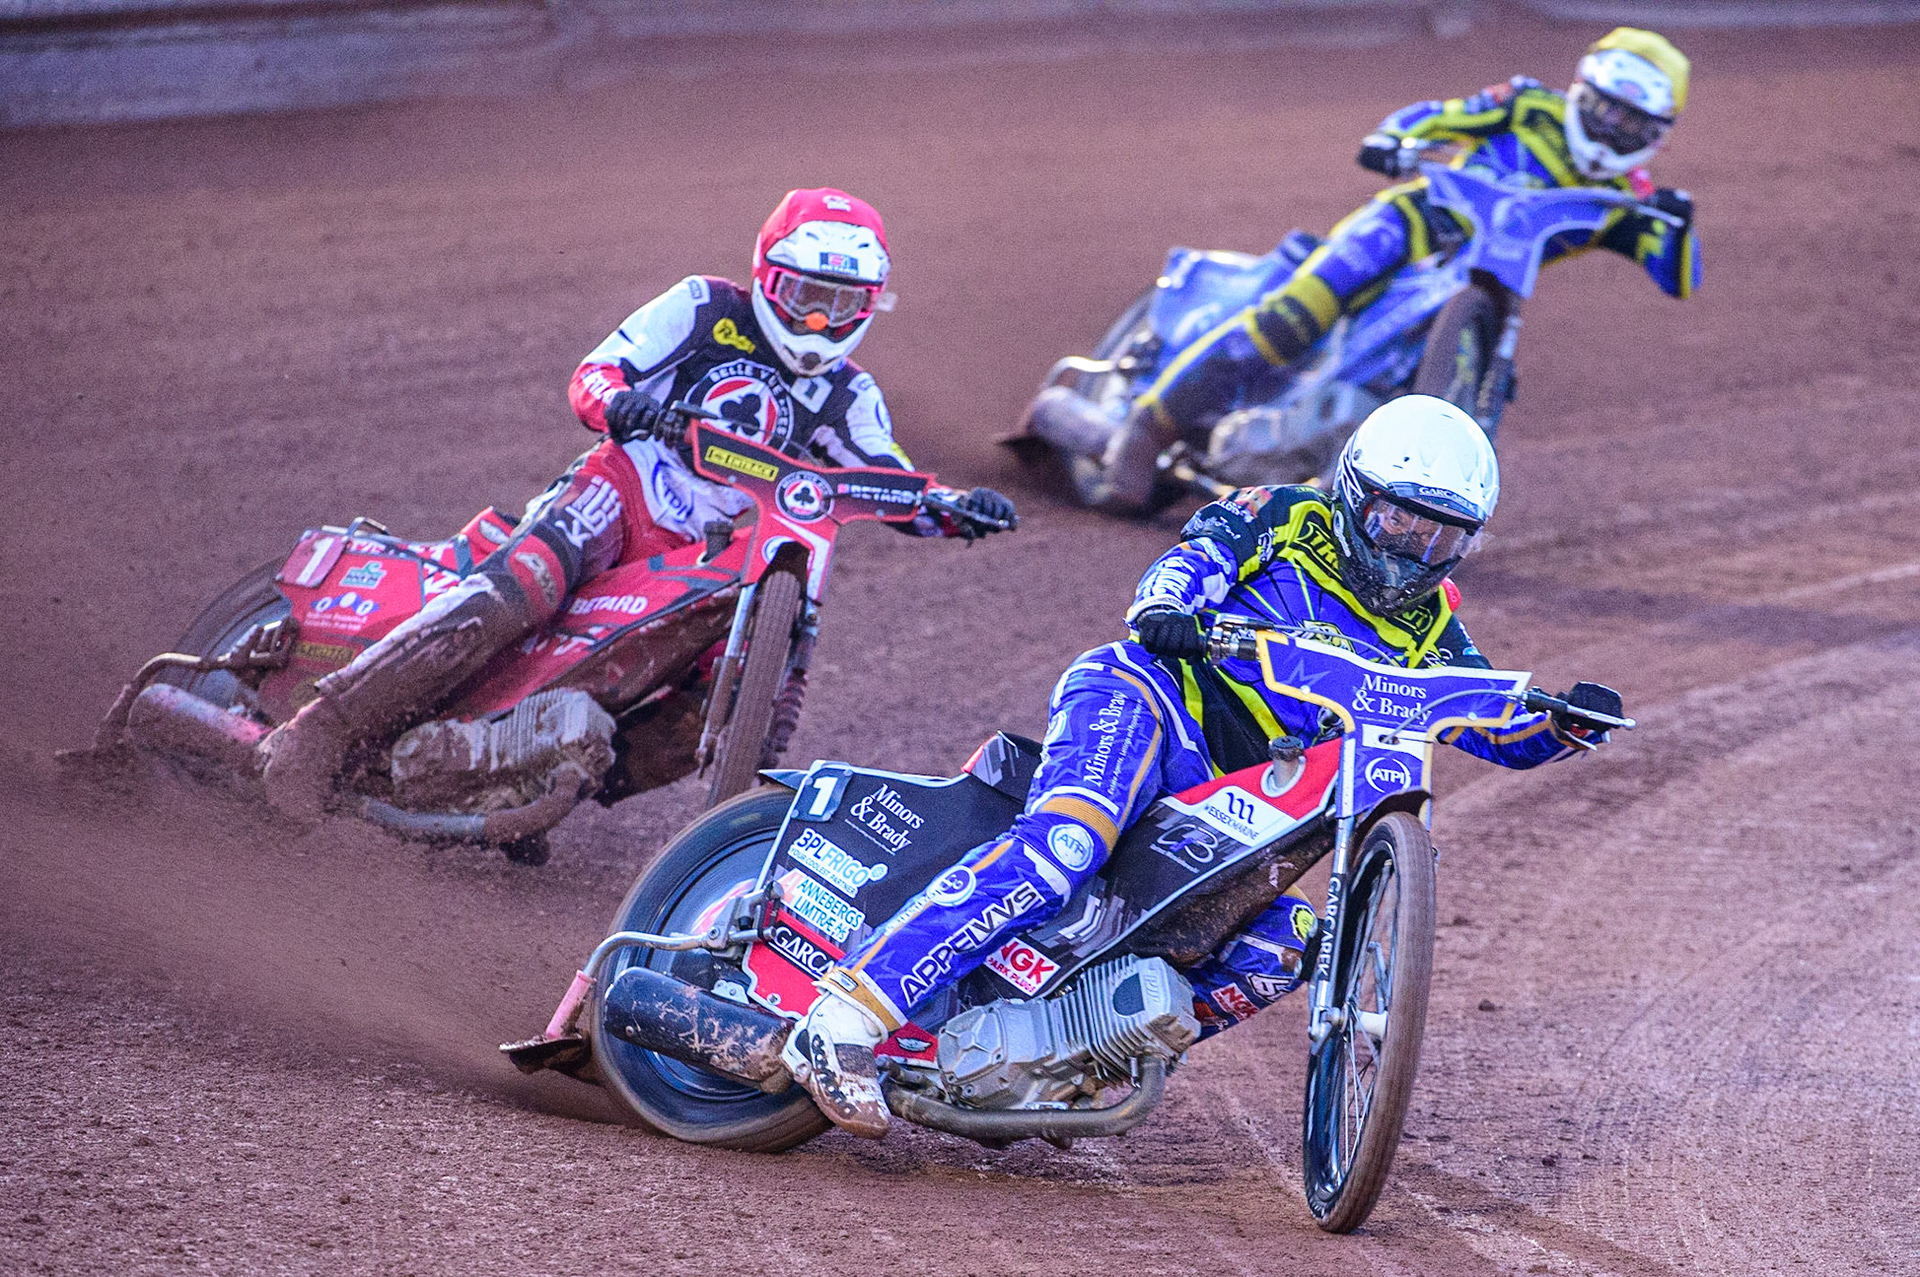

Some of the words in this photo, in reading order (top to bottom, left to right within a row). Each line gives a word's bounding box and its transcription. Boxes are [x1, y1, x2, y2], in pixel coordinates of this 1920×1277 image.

[709, 363, 754, 383] BELLE
[295, 537, 335, 584] 1
[1352, 689, 1376, 713] &
[1378, 697, 1433, 726] Brady
[1361, 673, 1427, 699] Minors
[1088, 718, 1119, 734] &
[1083, 734, 1115, 787] Minors
[1371, 767, 1405, 785] ATPI
[808, 776, 839, 816] 1
[870, 783, 925, 829] Minors
[850, 796, 875, 822] &
[866, 811, 913, 852] Brady
[796, 831, 869, 885] 3PLFRIGO
[797, 879, 862, 928] ANNEBERGS
[1318, 876, 1342, 976] GARCAREK
[988, 957, 1010, 978] PARK
